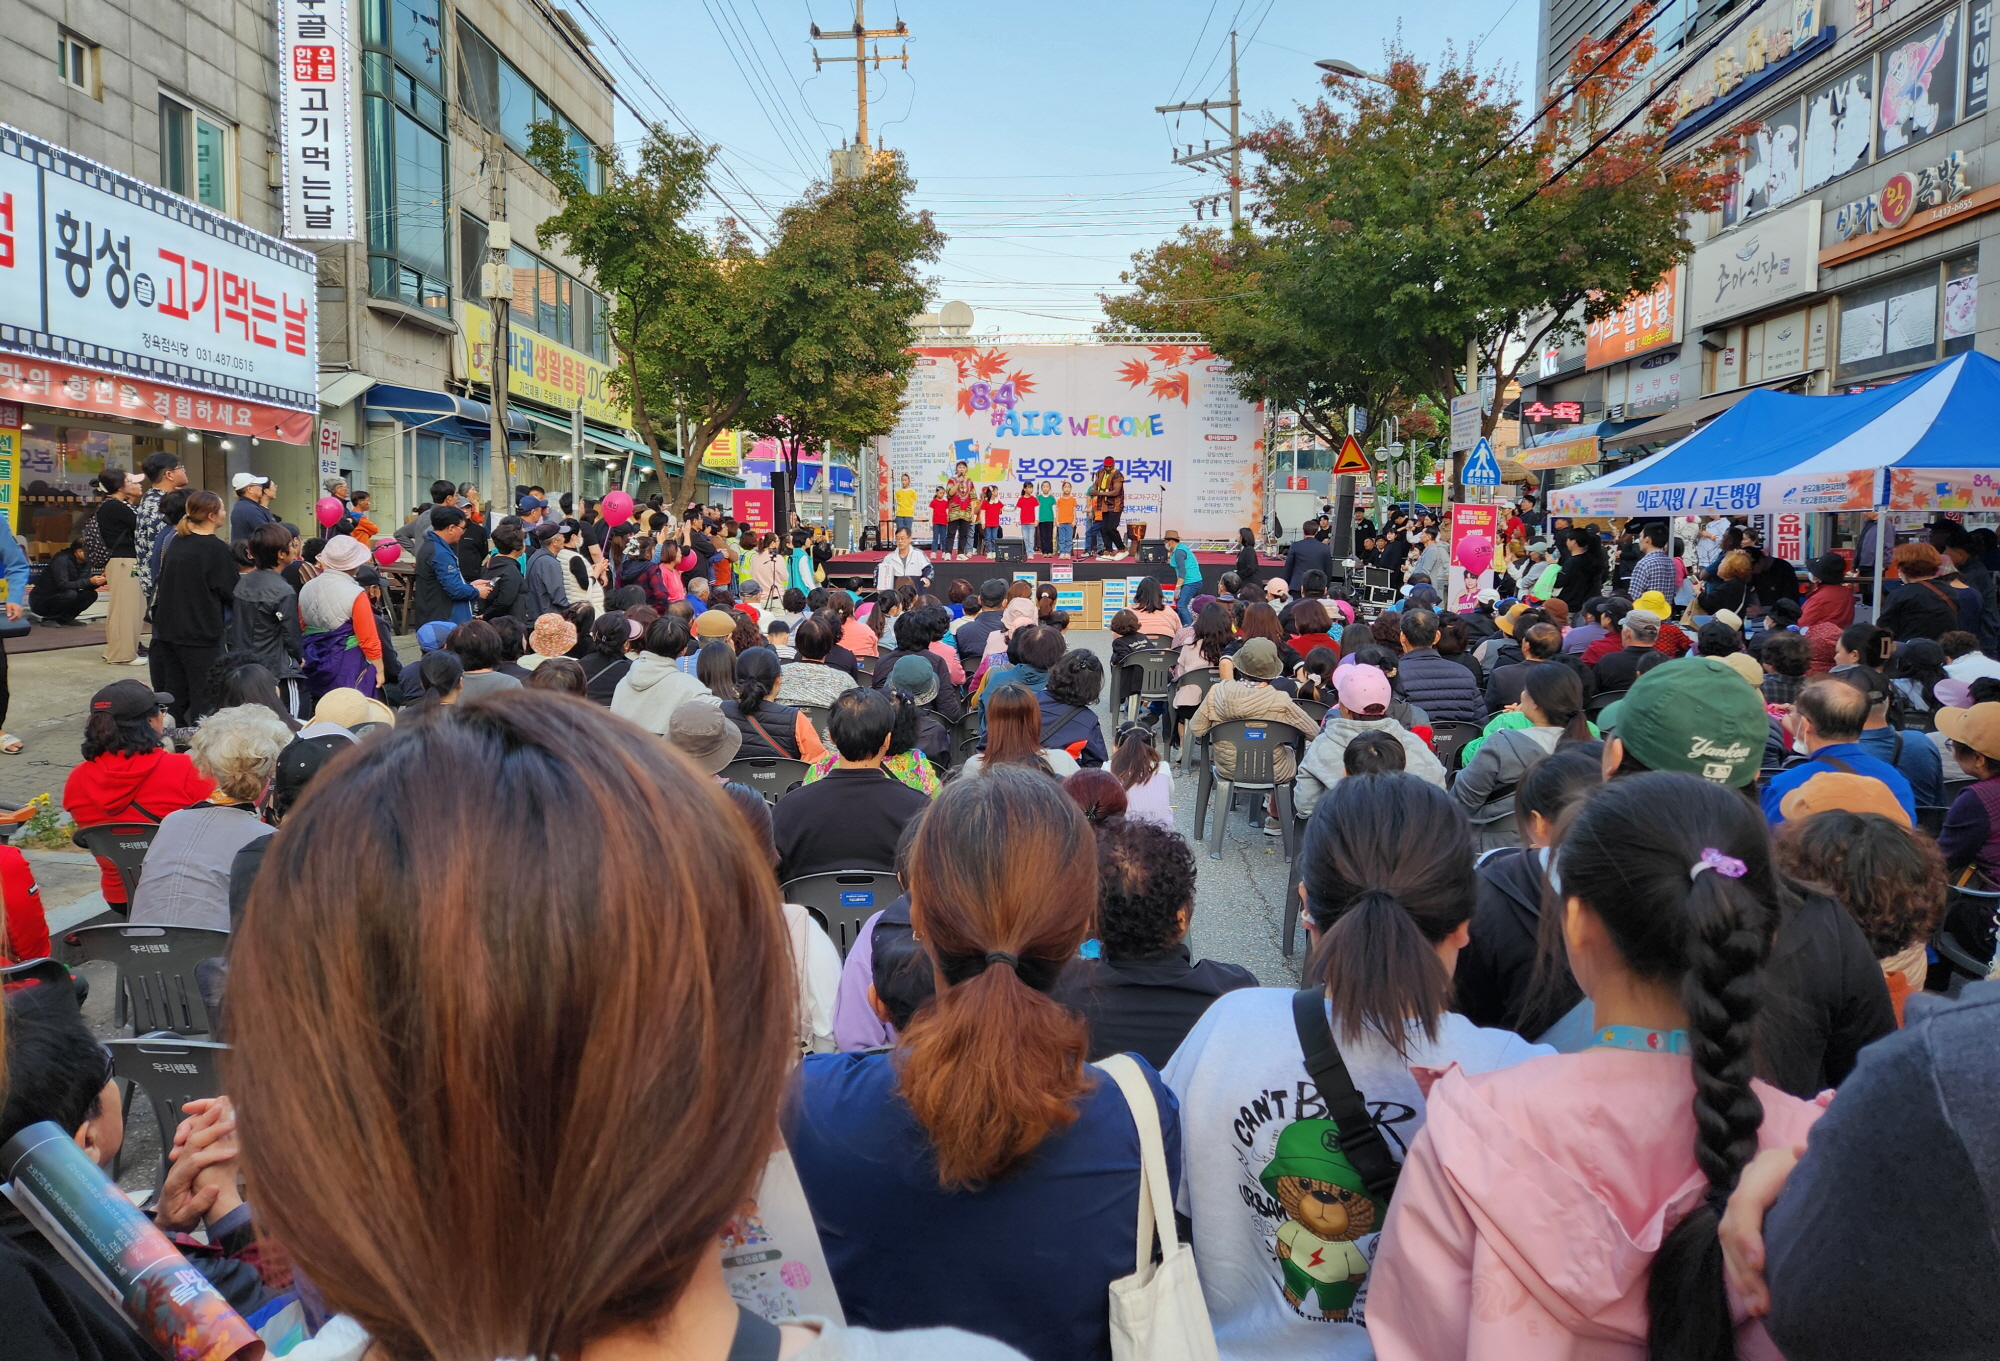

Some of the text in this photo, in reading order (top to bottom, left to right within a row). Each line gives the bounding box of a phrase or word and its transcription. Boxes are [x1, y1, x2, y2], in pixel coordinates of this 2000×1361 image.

[299, 88, 335, 229] 고기먹는날
[157, 247, 309, 358] 고기먹는날
[196, 347, 254, 373] 031.487.0515
[534, 343, 586, 397] 생활용품
[152, 391, 252, 427] 경험하세요
[967, 380, 1019, 411] 84
[1068, 413, 1166, 439] WELCOME
[320, 427, 341, 457] 유리
[1015, 457, 1089, 483] 본오2동
[1466, 476, 1496, 485] 횡단보도
[1635, 487, 1686, 512] 의료지원
[1700, 482, 1762, 511] 고든병원
[752, 771, 776, 780] 우리렌탈
[119, 840, 150, 851] 우리렌탈
[129, 943, 171, 954] 우리렌탈
[151, 1061, 199, 1074] 우리렌탈
[1233, 1088, 1288, 1148] CAN'T
